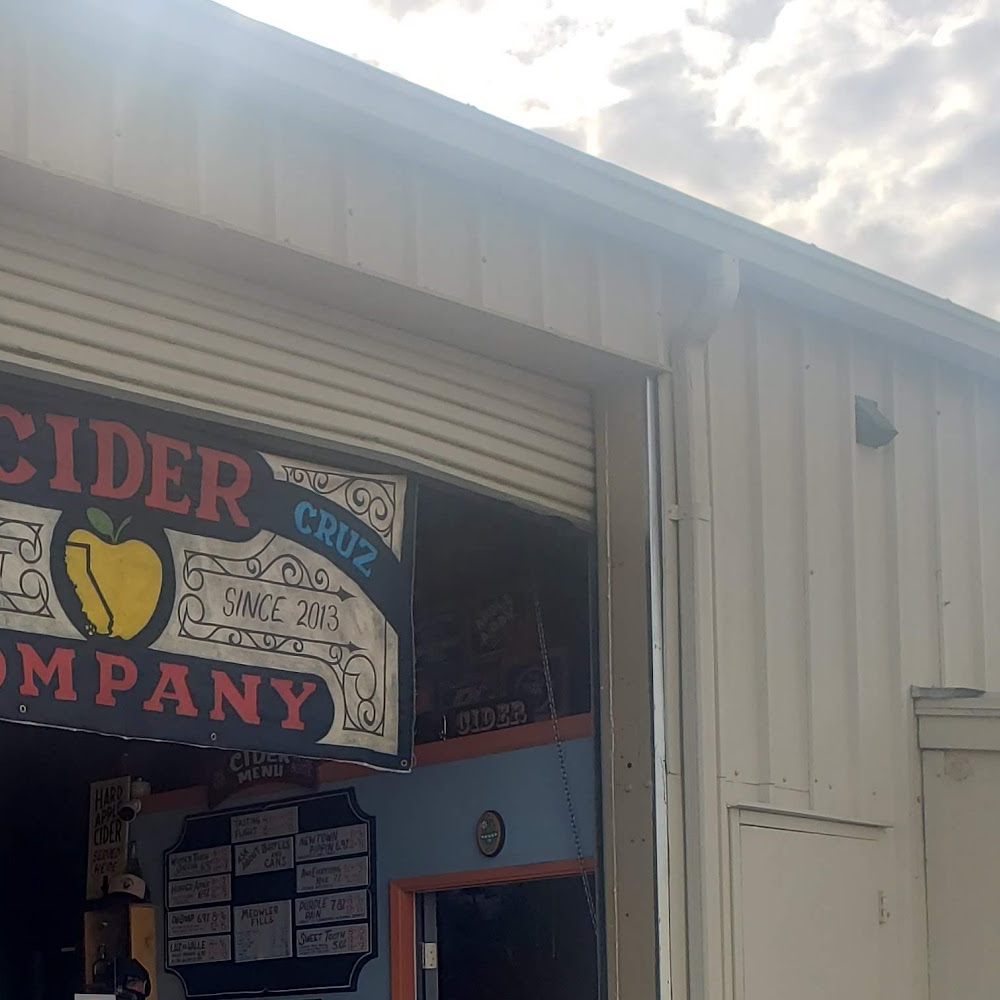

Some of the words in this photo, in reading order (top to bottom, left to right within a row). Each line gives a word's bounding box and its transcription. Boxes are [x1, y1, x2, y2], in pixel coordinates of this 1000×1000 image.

[293, 499, 380, 580] CRUZ
[221, 587, 283, 624] SINCE
[296, 599, 341, 632] 2013
[237, 764, 284, 785] MENU
[94, 819, 122, 847] CIDER
[264, 856, 287, 869] CANS
[251, 914, 275, 927] FILLS
